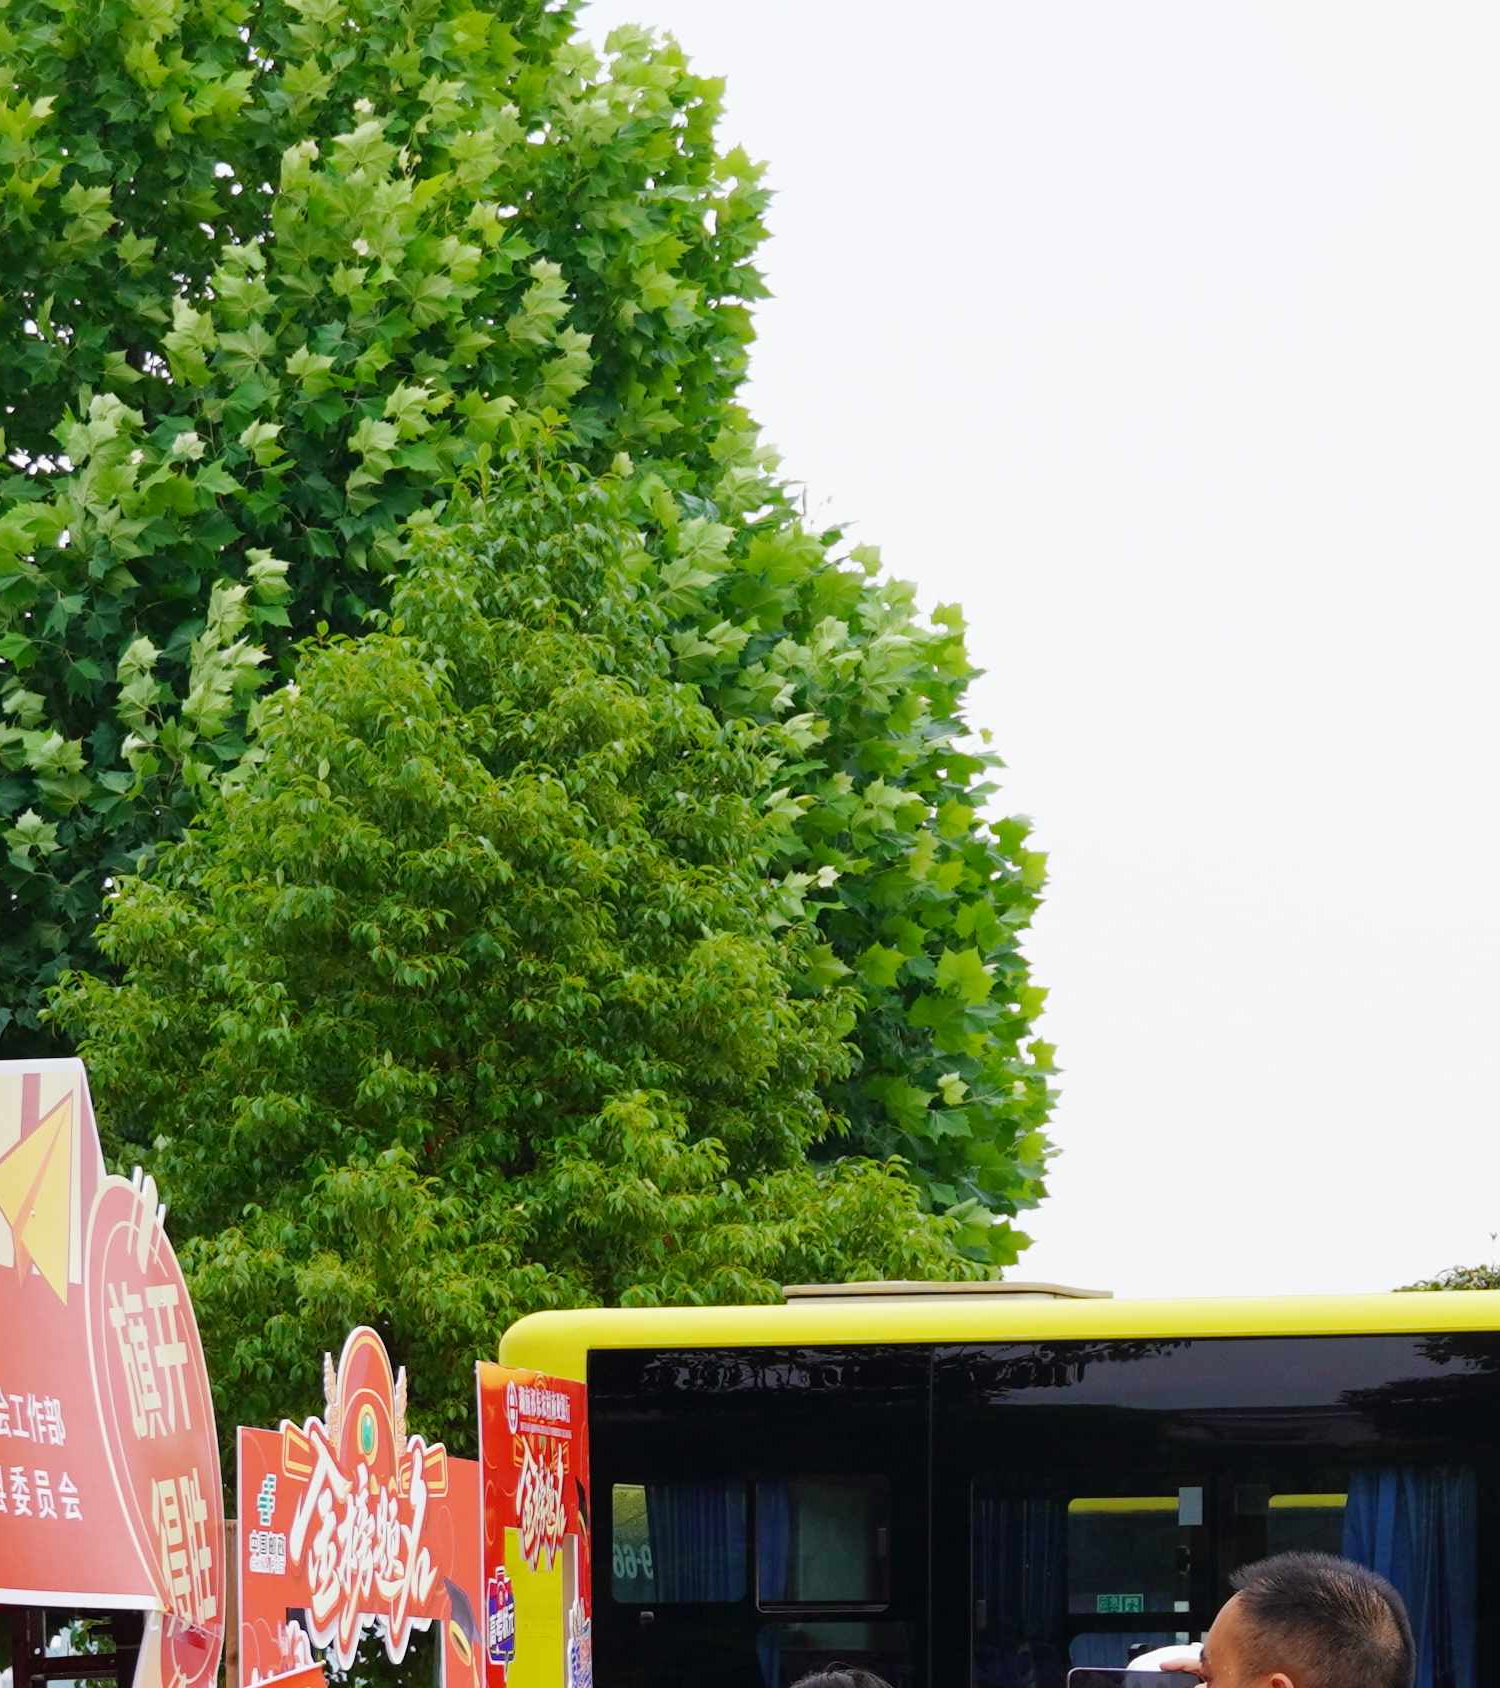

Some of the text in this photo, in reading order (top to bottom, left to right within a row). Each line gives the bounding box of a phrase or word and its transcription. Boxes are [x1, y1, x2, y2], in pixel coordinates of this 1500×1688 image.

[110, 1280, 191, 1442] 旗开
[151, 1468, 215, 1631] 得胜
[290, 1429, 438, 1643] 金榜题名
